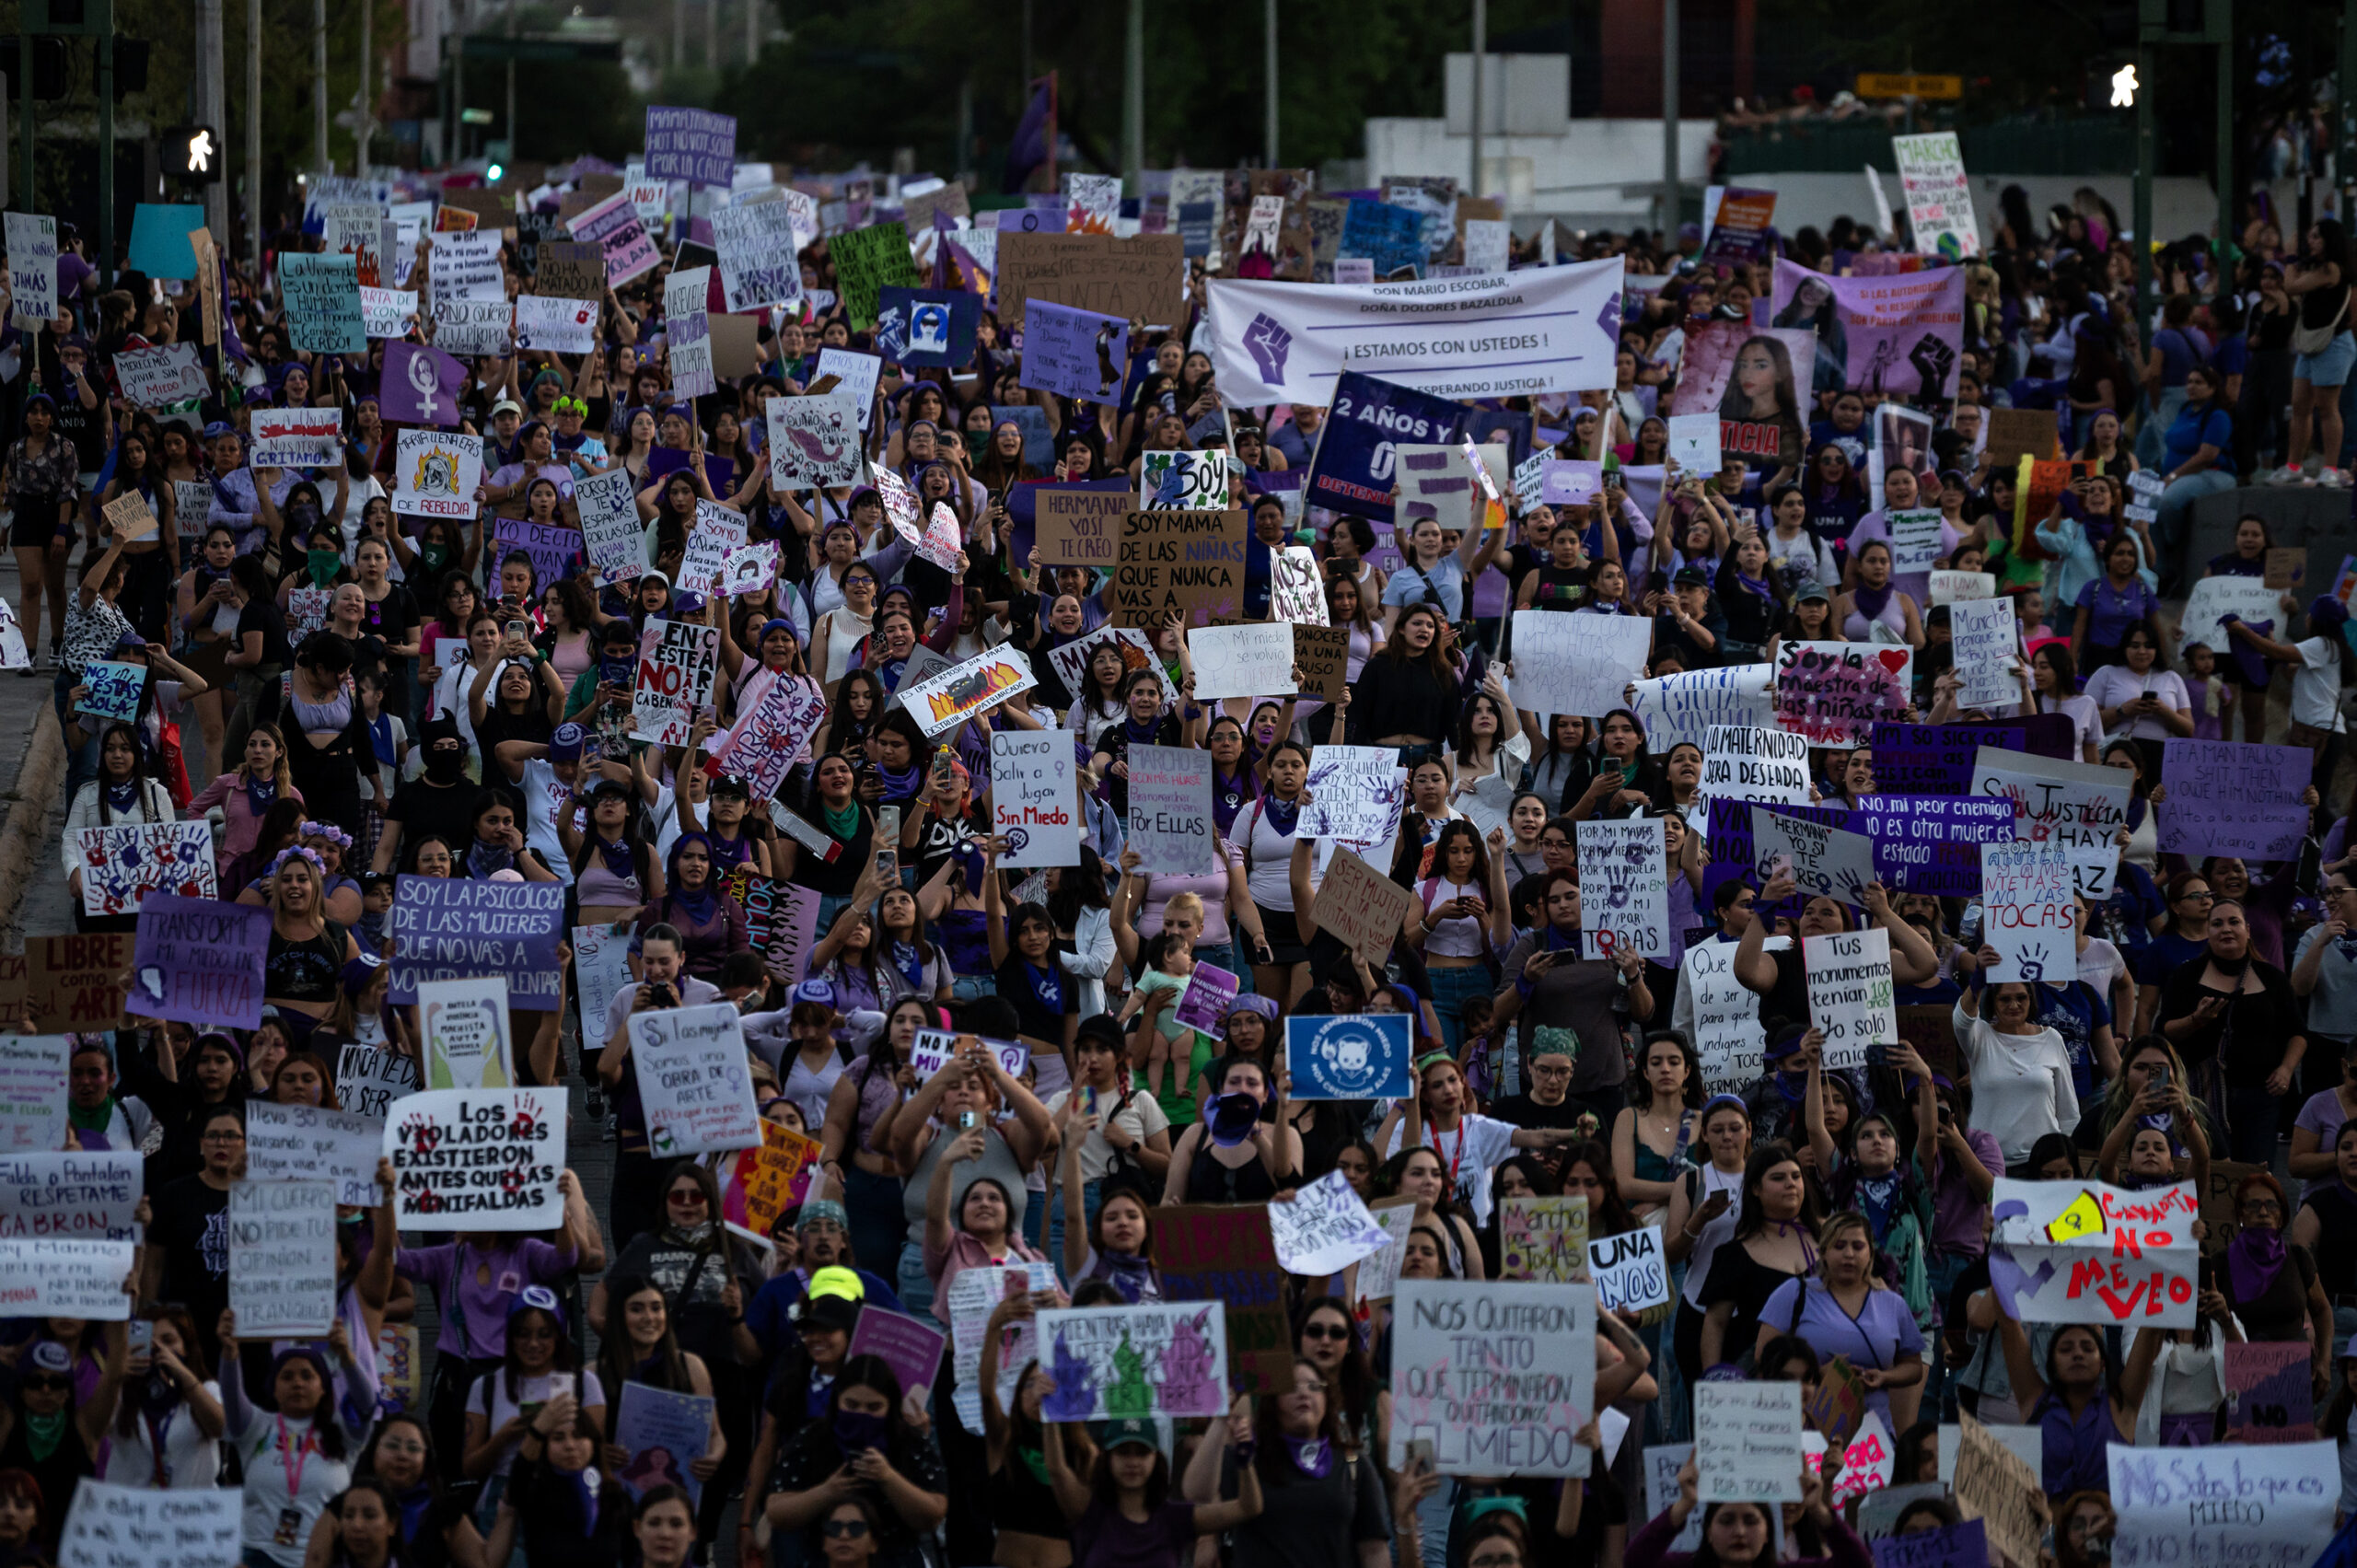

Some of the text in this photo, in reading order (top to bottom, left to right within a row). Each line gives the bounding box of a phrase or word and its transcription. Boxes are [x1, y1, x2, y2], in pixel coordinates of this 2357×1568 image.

[1898, 139, 1959, 161] MARCHO
[653, 155, 729, 181] POR CALLE
[13, 269, 47, 293] JAMÁS
[540, 276, 586, 290] MATADO
[1405, 284, 1446, 296] MARIO
[16, 299, 51, 318] TOCAR
[296, 296, 345, 311] HUMANO
[1400, 295, 1524, 314] DOLORES BAZALDUA
[1851, 311, 1962, 326] SON PARTE PROBLEMA
[1354, 334, 1538, 359] ESTAMOS CON USTEDES
[119, 355, 171, 372] MERECEMOS
[131, 368, 179, 385] VIVIR SIN
[1493, 377, 1547, 393] JUSTICIA
[146, 382, 180, 397] MIEDO
[1335, 398, 1454, 443] 2 AÑOS Y
[398, 499, 470, 516] DE REBELDIA
[1048, 496, 1129, 515] HERMANA
[182, 521, 199, 533] No
[498, 518, 519, 540] YO
[583, 507, 633, 529] ESPANTAS
[1124, 508, 1223, 536] SOY MAMÁ
[1815, 516, 1844, 526] UNA
[586, 520, 642, 545] POR QUE
[1061, 539, 1112, 558] TE CREO
[1120, 535, 1243, 563] DE LAS NIÑAS
[1120, 566, 1232, 587] QUE NUNCA
[1118, 589, 1160, 607] VAS
[1955, 609, 2011, 633] Marcho
[665, 622, 697, 648] EN
[1233, 629, 1284, 644] Mi miedo
[656, 645, 698, 668] ESTE
[1315, 646, 1341, 659] UNA
[1780, 641, 1863, 672] Soy la
[637, 660, 680, 695] NO
[929, 645, 1006, 689] HERMOSO PARA
[1596, 659, 1616, 678] NO
[93, 679, 144, 702] ESTAS
[1778, 673, 1889, 694] maestra de
[83, 697, 128, 715] SOLA
[636, 691, 672, 709] CABEN
[924, 681, 1026, 737] DESTRUIR PATRIARCADO
[1816, 697, 1874, 720] niñas
[993, 735, 1050, 757] Quiero
[1708, 727, 1806, 761] LA MATERNIDAD
[1913, 729, 1978, 746] SO SICK
[1130, 749, 1189, 772] MARCHO
[2201, 745, 2284, 765] MAN TALKS
[993, 761, 1025, 782] Salir
[1340, 761, 1392, 776] SIGUIENTE
[1705, 760, 1803, 790] SERA DESEADA
[2238, 768, 2282, 787] THEN
[1019, 783, 1056, 804] Jugar
[2026, 784, 2123, 823] JUSTICIA
[2218, 785, 2242, 800] HIM
[997, 805, 1068, 826] Sin Miedo
[1916, 800, 2012, 818] peor enemigo
[2238, 810, 2297, 825] violencia
[1131, 807, 1205, 835] Por ELLAS
[1775, 819, 1829, 843] HERMANA
[1910, 821, 1943, 836] otra
[142, 823, 184, 843] HACE
[1579, 826, 1598, 839] POR
[2058, 830, 2113, 847] HAY
[1788, 838, 1807, 852] YO
[1883, 844, 1930, 864] estado
[1580, 864, 1656, 876] POR ABUELA
[1797, 852, 1818, 868] TE
[400, 879, 471, 906] SOY LA
[1335, 859, 1404, 921] SER MUJER
[1992, 887, 2065, 903] NO LAS
[1582, 899, 1610, 911] POR
[394, 907, 552, 935] DE LAS MUJERES
[1987, 903, 2073, 930] TOCAS
[47, 935, 123, 971] LIBRE
[157, 943, 228, 968] MI MIEDO
[436, 940, 505, 966] NO VAS
[1826, 935, 1861, 957] Tus
[1693, 947, 1726, 979] Que
[1808, 961, 1891, 986] monumentos
[61, 972, 107, 988] como
[1871, 980, 1892, 999] 100
[174, 971, 251, 1016] FUERZA
[1701, 982, 1738, 1005] de ser
[440, 1023, 486, 1034] MACHISTA
[1700, 1014, 1724, 1031] para
[1822, 1014, 1844, 1039] Yo
[921, 1034, 940, 1048] NO
[1318, 1015, 1392, 1058] SEMBRARON MIEDO
[710, 1065, 725, 1079] DE
[1311, 1062, 1325, 1083] NOS
[357, 1086, 391, 1118] SER
[460, 1100, 505, 1124] Los
[294, 1107, 319, 1128] 35
[399, 1122, 550, 1144] VIOLADORES
[393, 1145, 534, 1168] EXISTIERON
[64, 1160, 132, 1184] Pantalón
[400, 1171, 467, 1191] ANTES
[20, 1184, 130, 1208] RESPETAME
[403, 1188, 546, 1214] MINIFALDAS
[1504, 1205, 1585, 1232] Marcho
[233, 1222, 261, 1245] NO
[2114, 1227, 2173, 1260] NO
[1590, 1232, 1655, 1270] UNA
[2067, 1258, 2129, 1299] ME
[2097, 1272, 2192, 1320] VEO
[1413, 1296, 1575, 1331] NOS QUITARON
[1451, 1337, 1535, 1369] TANTO
[1457, 1370, 1573, 1402] TERMINARON
[2252, 1403, 2289, 1428] NO
[1466, 1426, 1573, 1469] MIEDO
